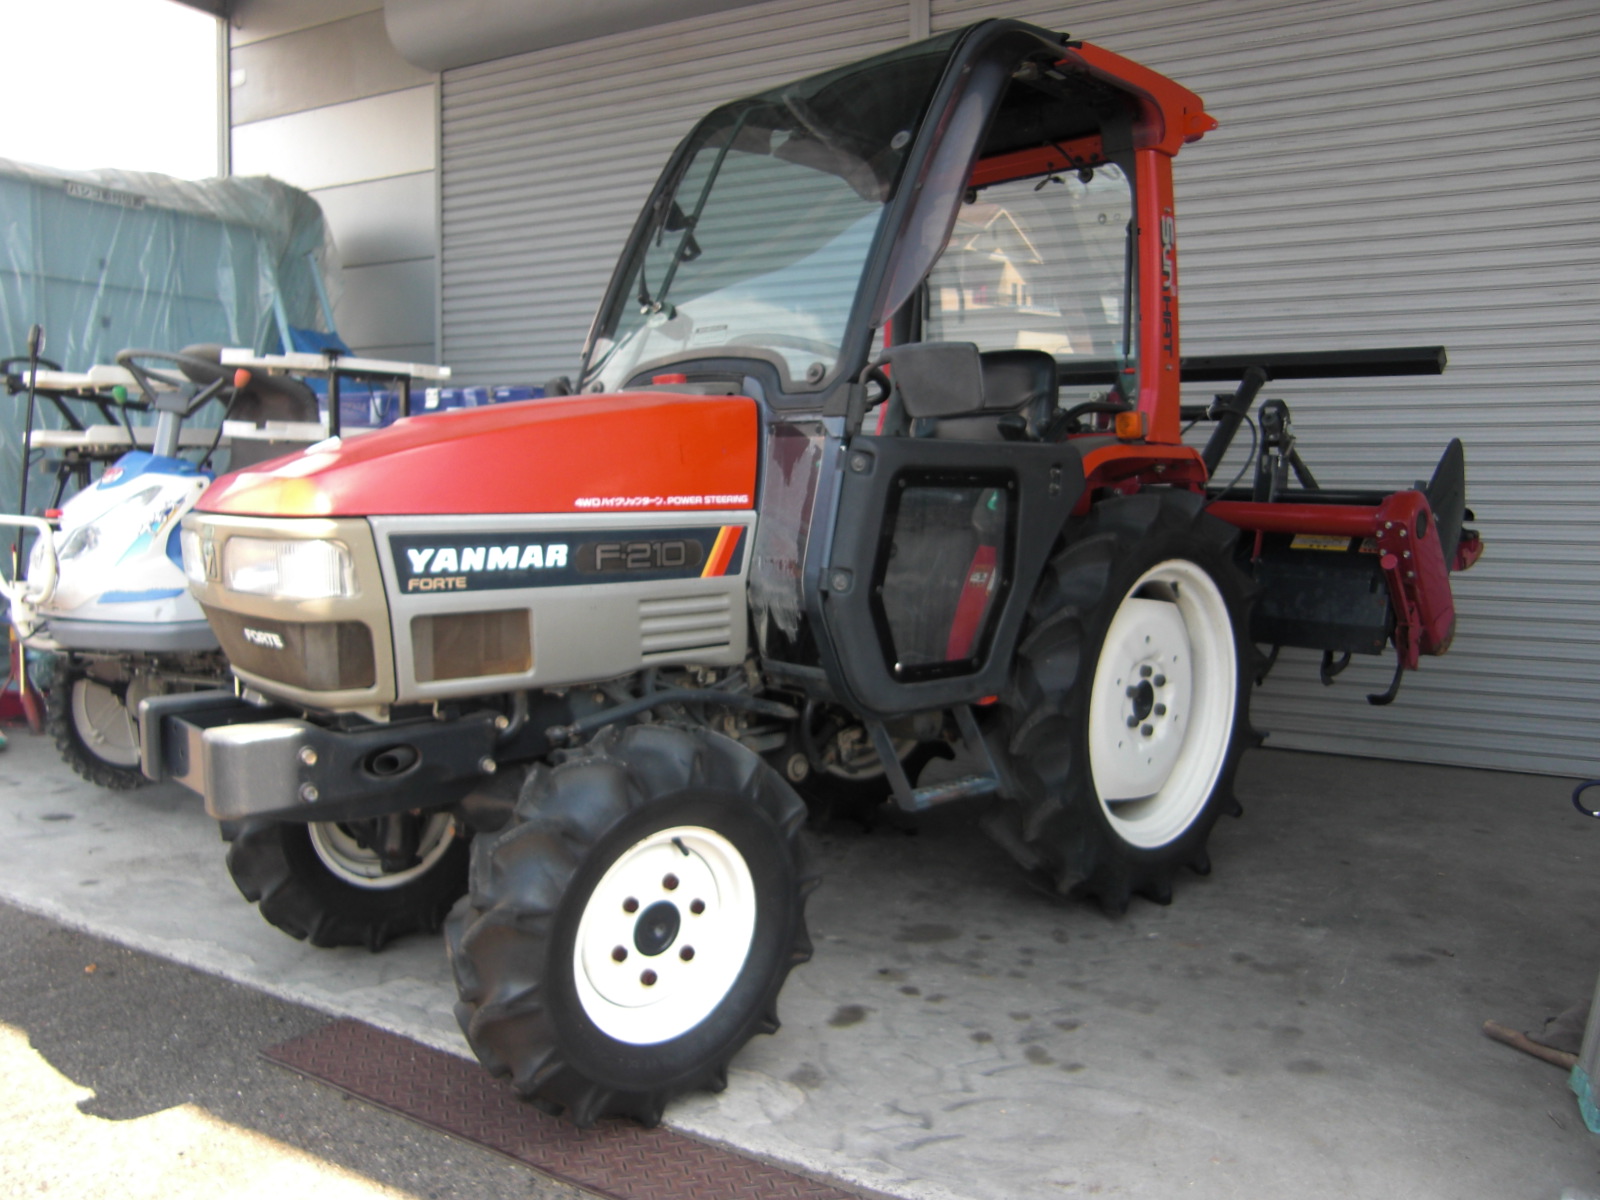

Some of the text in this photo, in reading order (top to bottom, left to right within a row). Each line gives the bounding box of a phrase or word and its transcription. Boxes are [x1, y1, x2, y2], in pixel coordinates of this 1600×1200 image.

[667, 495, 703, 505] POWER
[704, 494, 748, 504] STEERING
[407, 544, 568, 573] YANMAR
[407, 576, 467, 591] FORTE
[243, 627, 284, 650] FORTE
